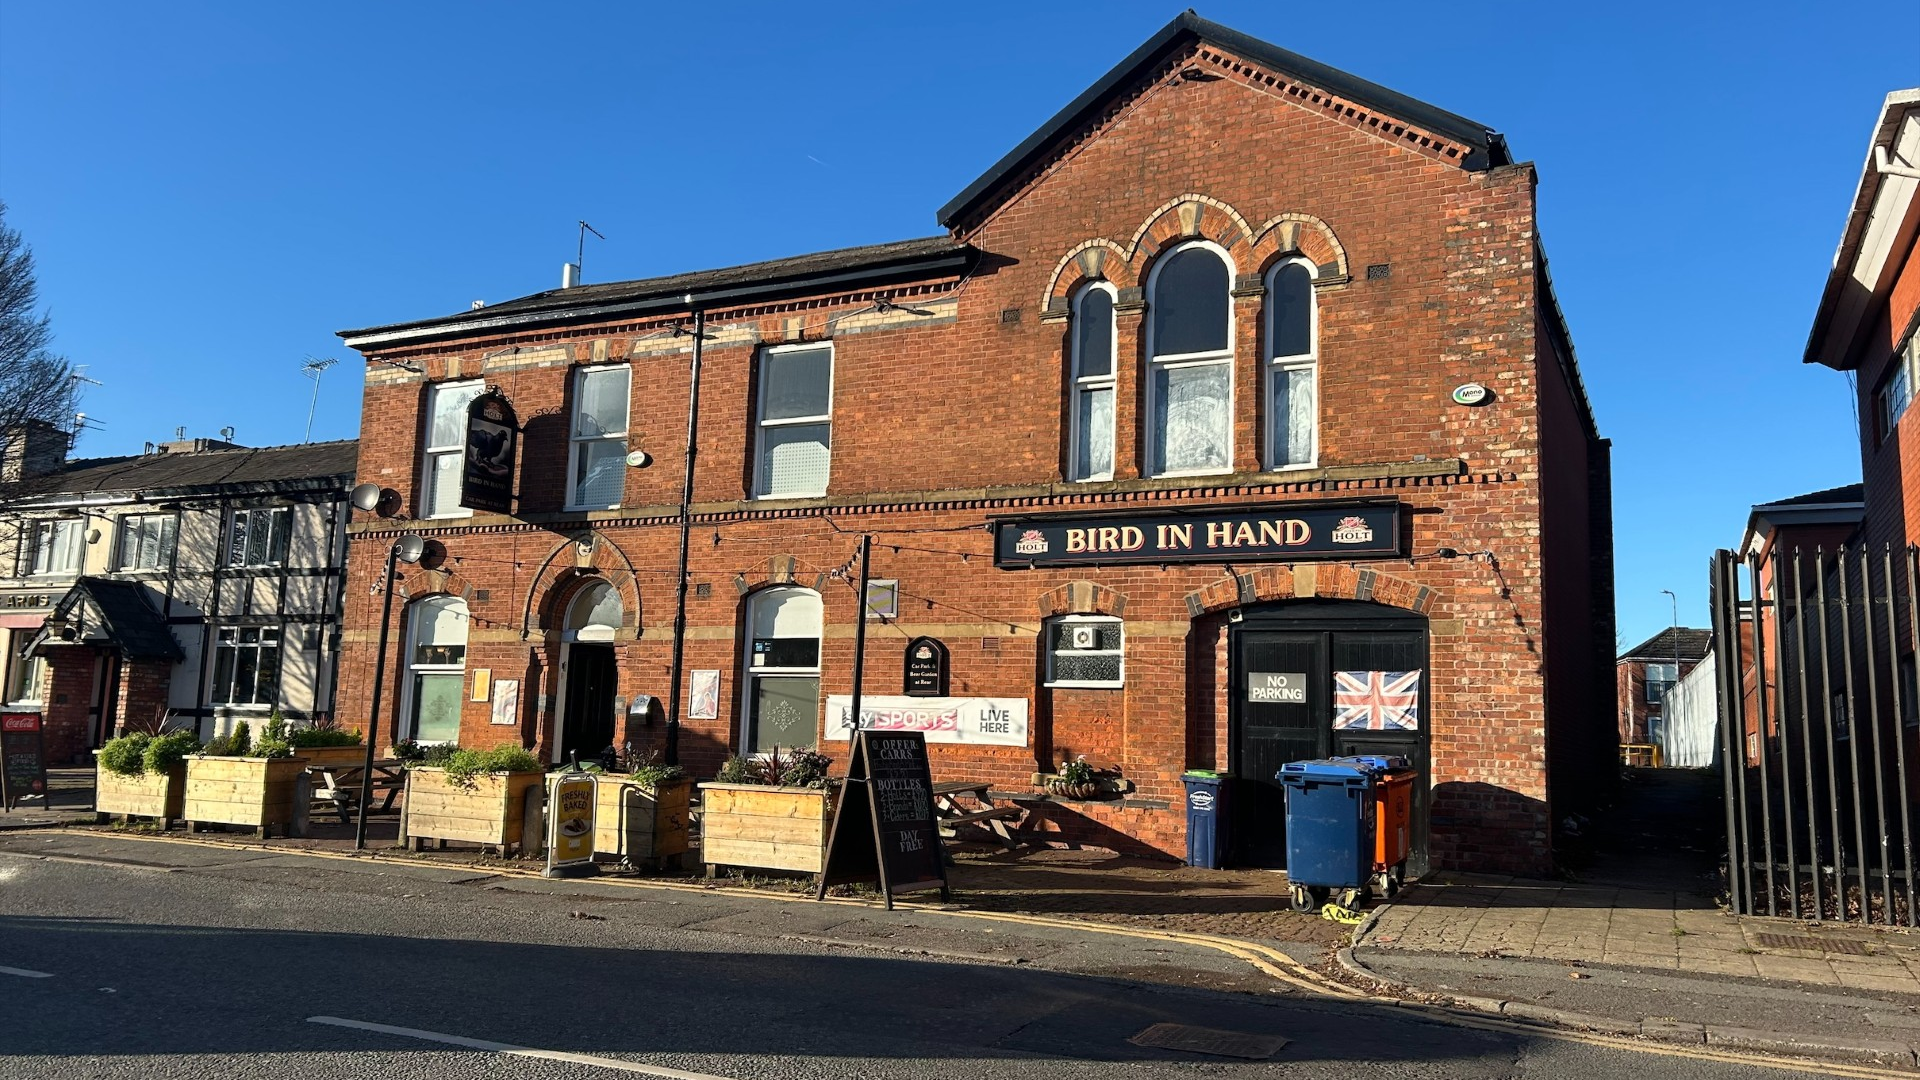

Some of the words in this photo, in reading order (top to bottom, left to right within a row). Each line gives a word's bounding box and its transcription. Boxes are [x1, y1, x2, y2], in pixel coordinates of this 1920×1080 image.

[1066, 526, 1145, 553] BIRD
[1157, 524, 1194, 549] IN
[1206, 519, 1312, 548] HAND
[1335, 531, 1371, 540] HOLT
[1018, 543, 1047, 552] HOLT
[7, 595, 50, 607] ARMS
[1267, 675, 1288, 688] NO
[1252, 687, 1303, 700] PARKING
[878, 710, 955, 728] SPORTS
[980, 709, 1009, 721] LIVE
[980, 722, 1009, 733] HERE
[880, 749, 913, 760] CARRS
[877, 779, 921, 791] BOTTLES
[561, 790, 588, 802] FRESHLY
[564, 801, 587, 811] BAKED
[900, 829, 919, 842] DAY
[900, 839, 924, 853] FREE
